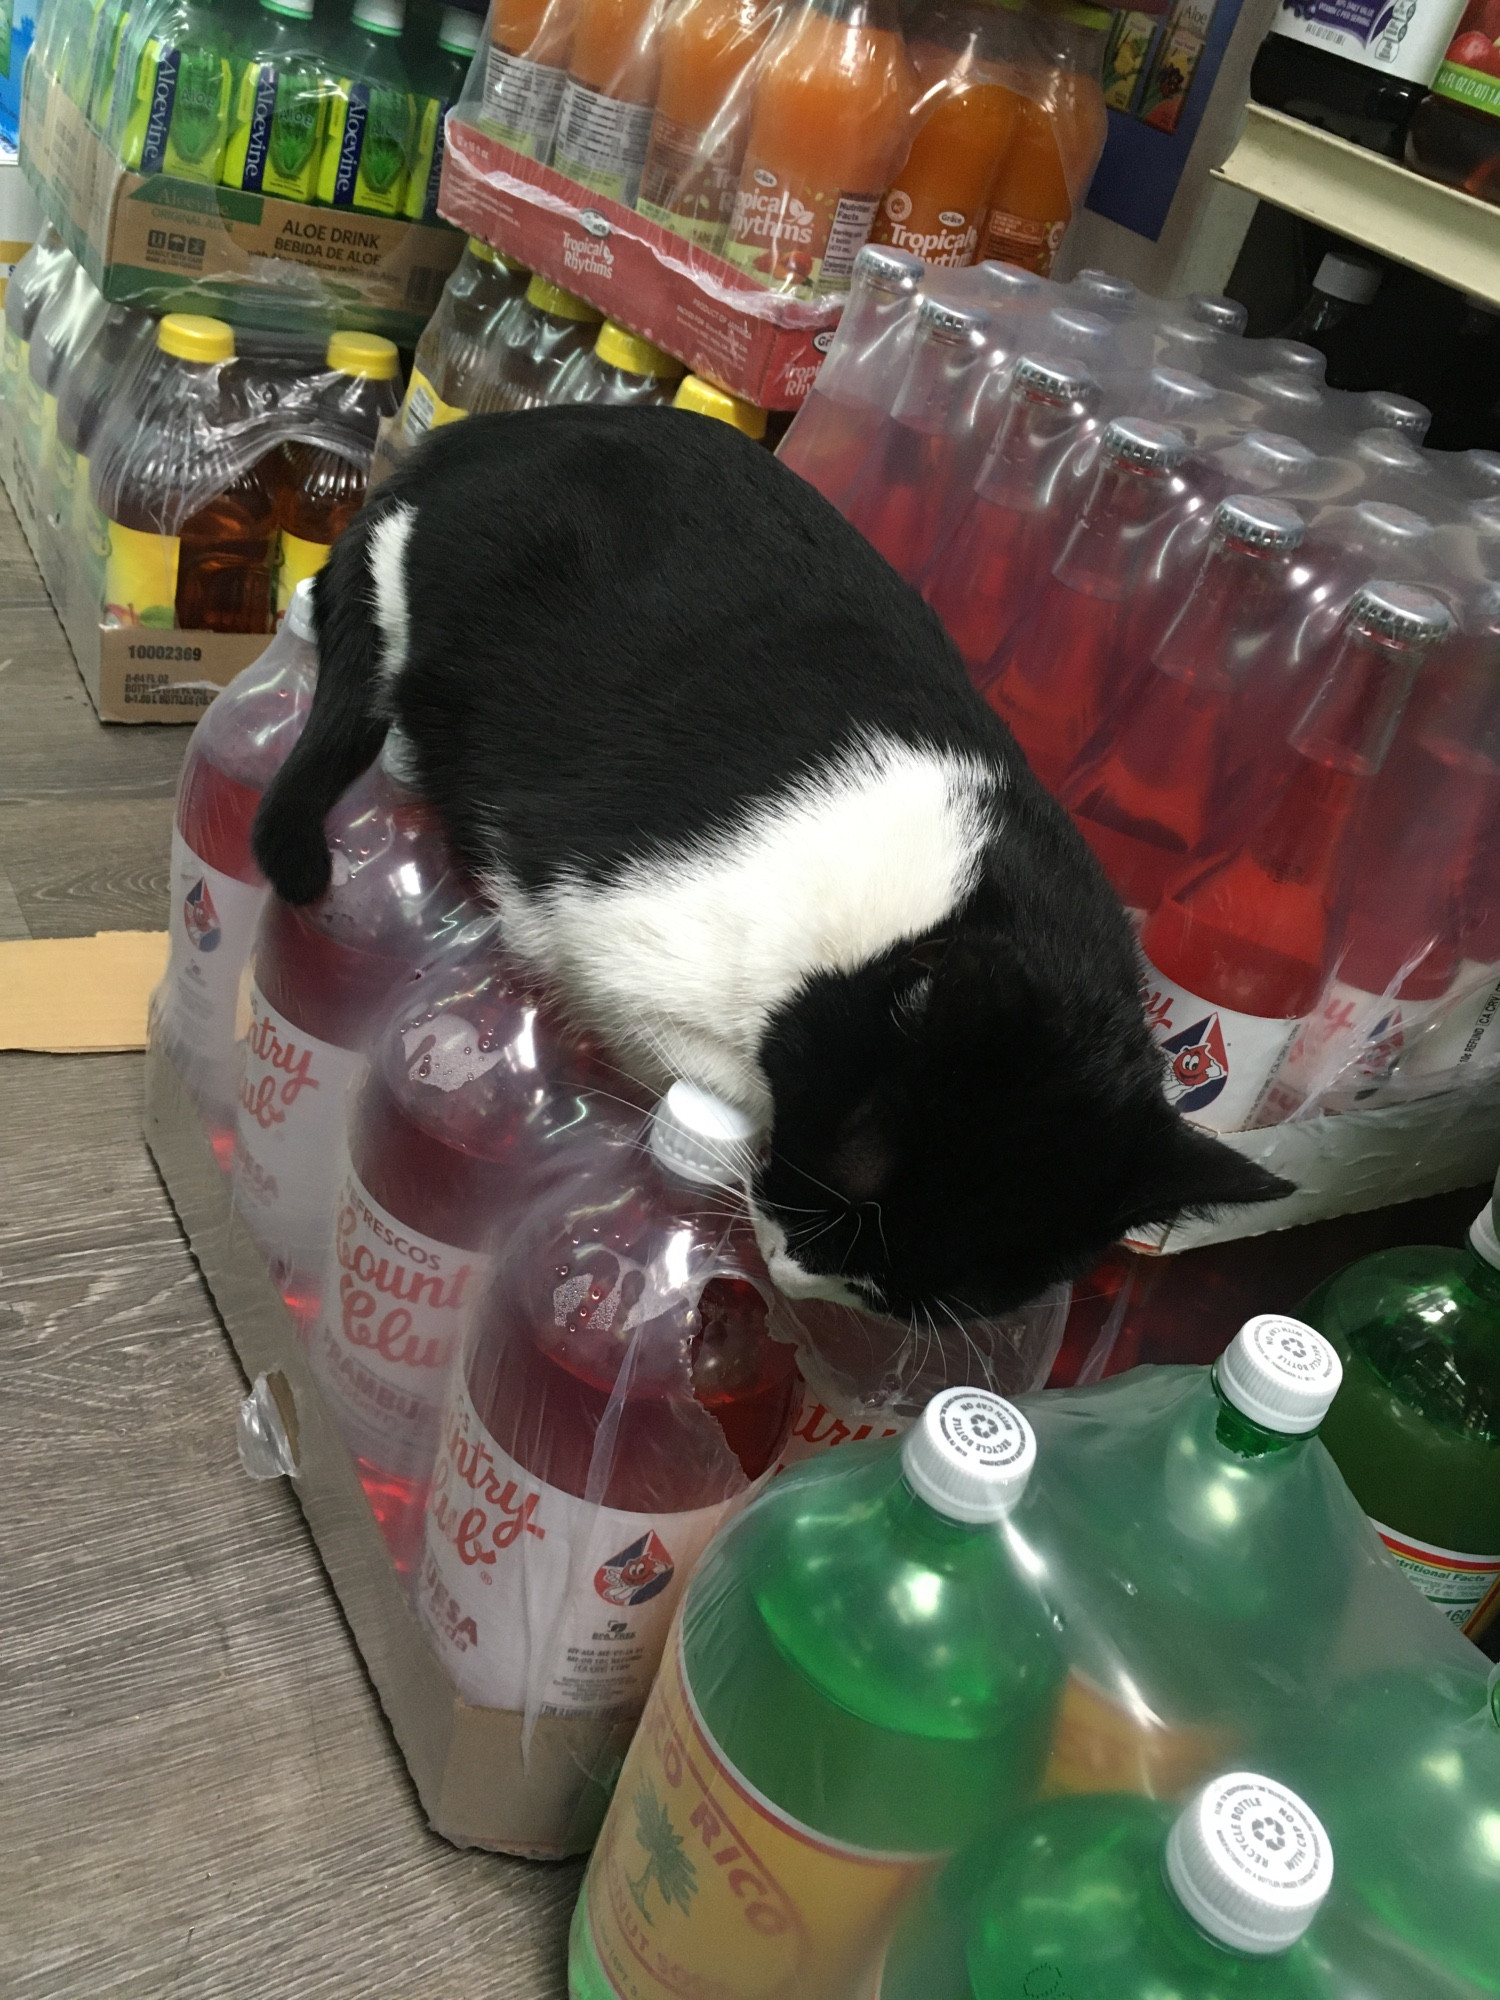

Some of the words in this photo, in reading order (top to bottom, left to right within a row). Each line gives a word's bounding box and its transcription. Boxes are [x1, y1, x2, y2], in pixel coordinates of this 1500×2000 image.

[144, 58, 177, 159] Aloevine
[278, 107, 314, 128] Aloe
[245, 76, 277, 177] Aloevine
[336, 92, 367, 192] Aloevine
[282, 219, 327, 240] ALOE
[330, 228, 381, 249] DRINK
[563, 231, 605, 257] Tropical
[890, 221, 973, 257] Tropical
[274, 237, 323, 257] BEBIDA
[325, 246, 345, 261] DE
[564, 249, 613, 279] Rhythms
[128, 645, 202, 661] 10002369
[1485, 995, 1500, 1012] CRV
[1478, 1013, 1493, 1024] CA
[1464, 1027, 1485, 1053] REFUND
[1280, 1326, 1303, 1338] WITH
[1277, 1354, 1310, 1372] BOTTLE
[960, 1402, 975, 1412] ON
[976, 1402, 994, 1412] CAP
[952, 1416, 975, 1447] BOTTLE
[994, 1410, 1013, 1432] WITH
[975, 1438, 1013, 1455] RECYCLE
[1452, 1573, 1486, 1582] Facts
[1230, 1797, 1262, 1821] BOTTLE
[1278, 1807, 1294, 1823] ON
[1230, 1824, 1269, 1869] RECYCLE
[1292, 1825, 1307, 1848] CAP
[689, 1800, 791, 1936] RICO
[1284, 1848, 1306, 1871] WITH
[1257, 1876, 1281, 1889] BOTTLER
[1281, 1880, 1298, 1889] UNDER
